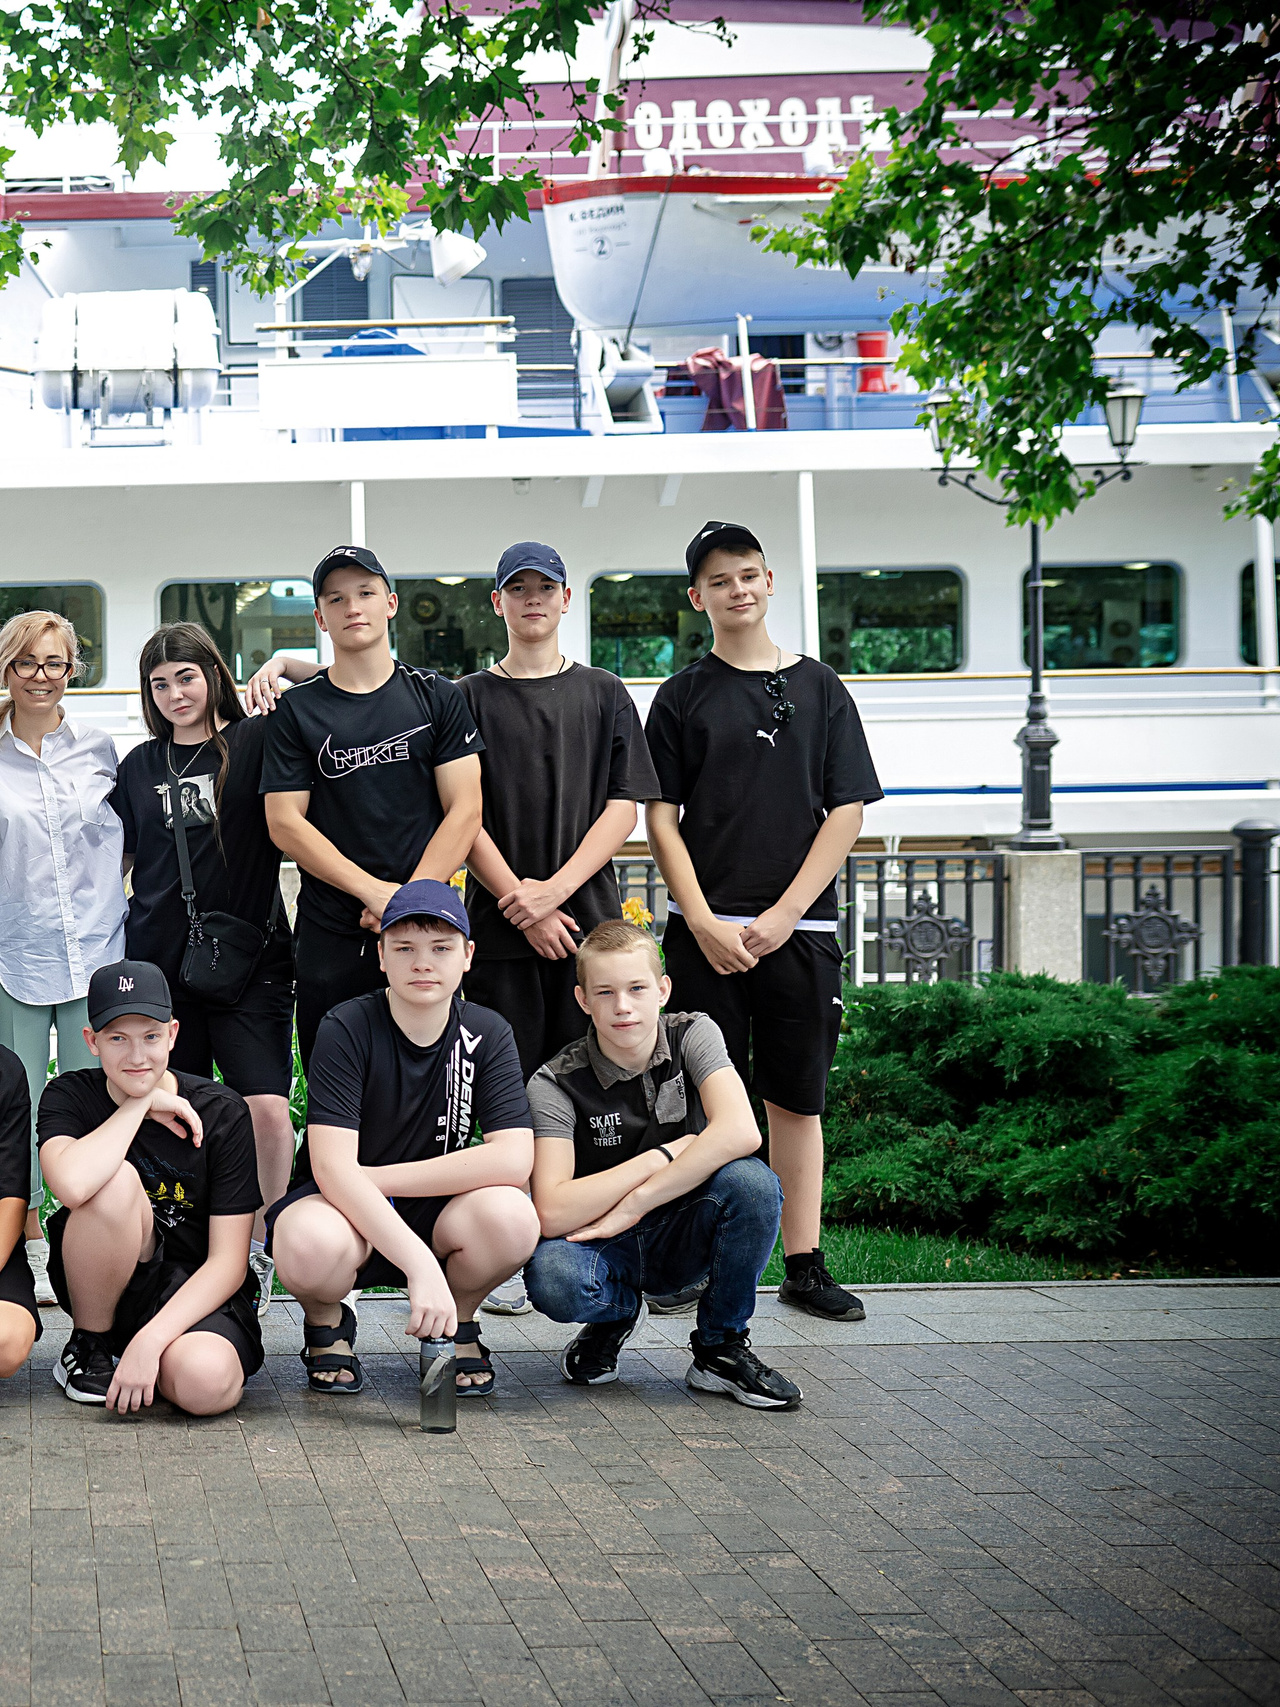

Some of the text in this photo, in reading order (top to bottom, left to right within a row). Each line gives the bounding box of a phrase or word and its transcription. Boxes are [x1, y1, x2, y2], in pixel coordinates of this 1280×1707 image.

[595, 239, 607, 255] 2
[334, 741, 410, 770] NIKE
[455, 1058, 475, 1148] DEMIX
[589, 1112, 622, 1129] SKATE
[593, 1135, 622, 1147] STREET
